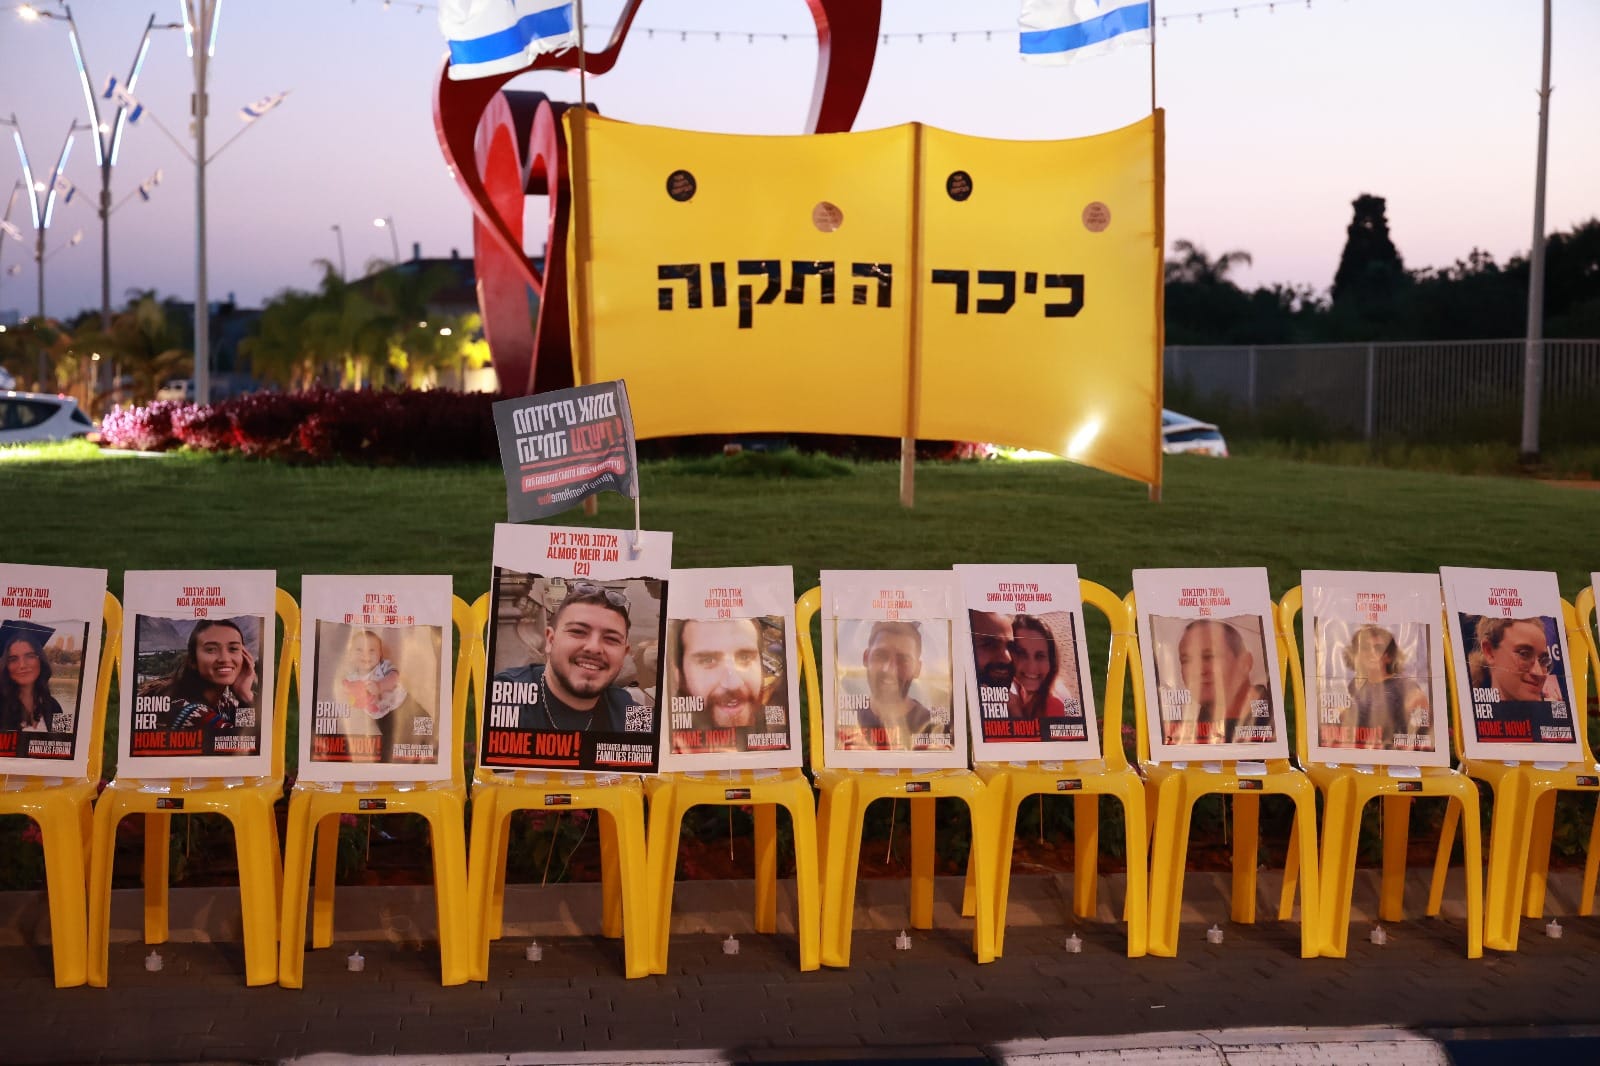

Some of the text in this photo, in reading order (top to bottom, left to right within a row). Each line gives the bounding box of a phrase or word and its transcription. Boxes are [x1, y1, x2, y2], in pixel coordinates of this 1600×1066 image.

[657, 259, 1085, 329] כיכר התקוה
[568, 532, 590, 547] מאיר
[547, 546, 619, 562] ALMOG MEIR JAN
[574, 561, 590, 576] (21)
[1, 597, 52, 609] NOA MARCIANO
[176, 597, 226, 607] NOA ARGAMANI
[19, 608, 32, 619] (19)
[492, 680, 538, 706] BRING
[980, 686, 1010, 702] BRING
[1473, 687, 1500, 703] BRING
[135, 696, 171, 712] BRING
[316, 702, 351, 718] BRING
[671, 696, 704, 712] BRING
[981, 702, 1009, 719] THEM
[1474, 703, 1494, 719] HER
[135, 713, 157, 730] HER
[490, 705, 520, 728] HIM
[671, 713, 692, 730] HIM
[1321, 708, 1341, 724] HER
[315, 718, 337, 735] HIM
[984, 720, 1012, 736] HOME
[1013, 718, 1041, 736] NOW!
[1477, 721, 1503, 737] HOME
[1505, 720, 1532, 737] NOW!
[134, 729, 203, 748] HOME NOW!
[314, 736, 347, 753] HOME
[488, 730, 581, 757] HOME NOW!
[705, 728, 737, 746] NOW!
[596, 750, 652, 764] FAMILIES FORUM
